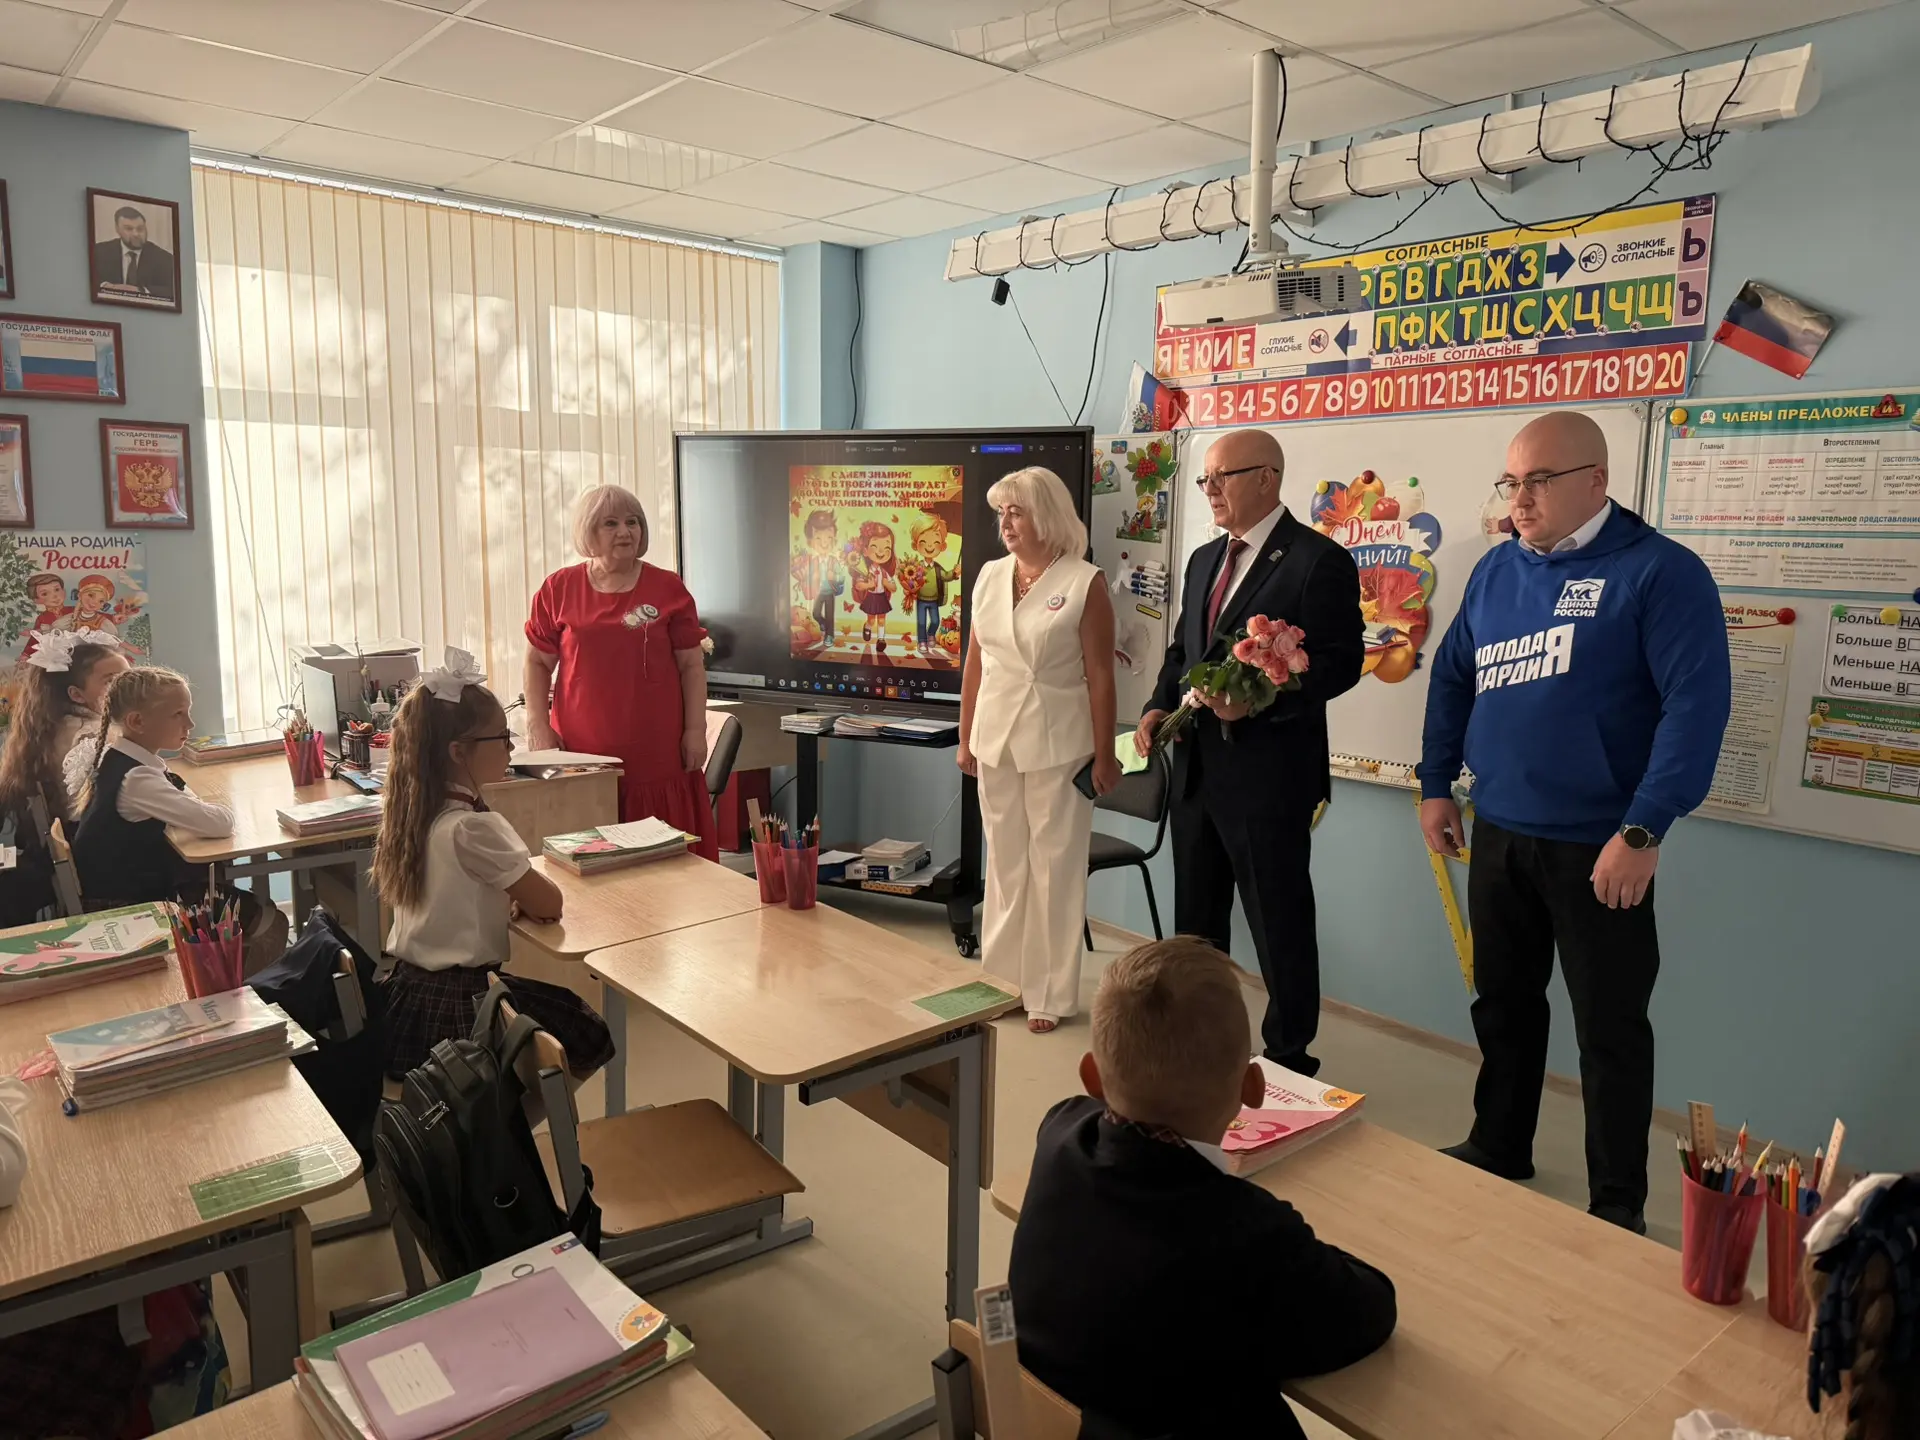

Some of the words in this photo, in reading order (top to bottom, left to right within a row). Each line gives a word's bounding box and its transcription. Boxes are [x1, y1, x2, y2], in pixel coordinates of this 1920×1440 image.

[1385, 235, 1489, 262] СОГЛАСНЫЕ
[1616, 237, 1667, 252] ЗВОНКИЕ
[1611, 247, 1676, 263] СОГЛАСНЫЕ
[1269, 335, 1296, 346] ГЛУХИЕ
[1261, 343, 1303, 355] СОГЛАСНЫЕ
[1384, 352, 1436, 366] ПАРНЫЕ
[1443, 343, 1524, 361] СОГЛАСНЫЕ
[1201, 393, 1215, 422] 2
[1219, 391, 1235, 420] 3
[1239, 389, 1256, 418] 4
[1260, 387, 1277, 417] 5
[1282, 384, 1299, 415] 6
[1304, 383, 1322, 414] 7
[1325, 380, 1344, 412] 8
[1350, 376, 1369, 410] 9
[1373, 375, 1394, 409] 10
[1397, 374, 1420, 408] 11
[1422, 371, 1446, 405] 12
[1448, 369, 1472, 403] 13
[1475, 367, 1499, 401] 14
[1503, 364, 1529, 399] 15
[1531, 361, 1558, 397] 16
[1561, 359, 1590, 396] 17
[1592, 355, 1620, 393] 18
[1623, 353, 1654, 392] 19
[1654, 350, 1686, 389] 20
[1722, 410, 1773, 423] ЧЛЕНЫ
[133, 439, 159, 447] ГЕРБ
[1344, 516, 1405, 546] Днём
[18, 536, 67, 548] НАША
[42, 549, 130, 570] Россия!
[1556, 601, 1598, 609] ЕДИНАЯ
[1554, 609, 1596, 618] РОССИЯ
[1747, 608, 1777, 618] РАЗБО
[1838, 612, 1895, 626] Больш
[1836, 633, 1892, 648] Больше
[1897, 637, 1907, 649] В
[1833, 654, 1895, 670] Меньше
[1830, 675, 1892, 692] Меньше
[1896, 682, 1906, 694] В
